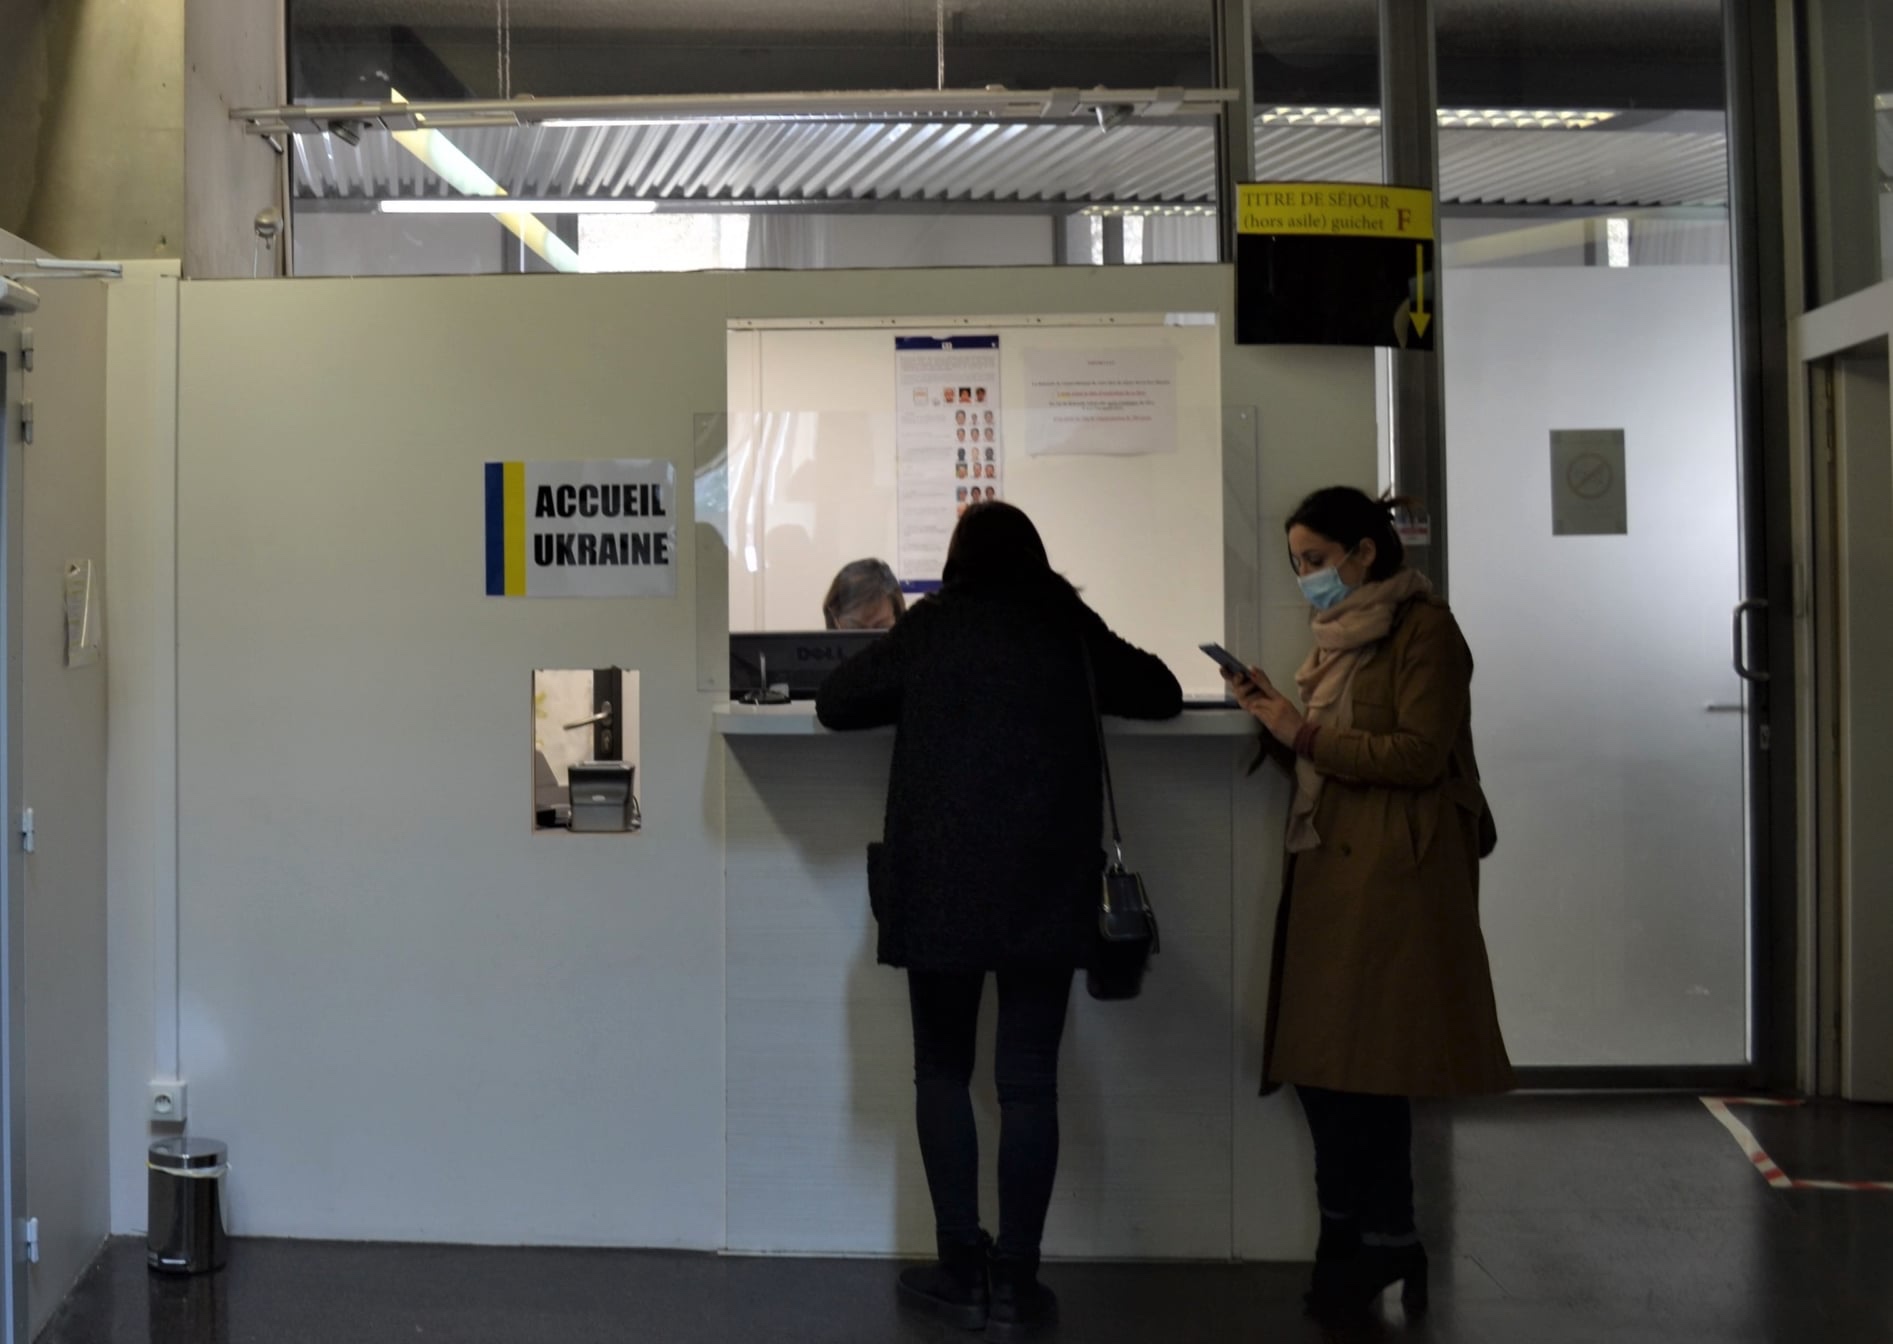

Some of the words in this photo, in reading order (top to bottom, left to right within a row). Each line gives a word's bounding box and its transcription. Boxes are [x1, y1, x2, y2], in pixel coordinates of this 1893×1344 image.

[1243, 191, 1295, 207] TITRE
[1301, 191, 1323, 207] DE
[1328, 189, 1390, 209] SÉJOUR
[1243, 213, 1284, 229] (hors
[1288, 213, 1327, 230] asile)
[1331, 214, 1384, 231] guichet
[1396, 208, 1411, 231] F
[535, 484, 666, 518] ACCUEIL
[534, 532, 669, 567] UKRAINE
[797, 647, 848, 661] DELL
